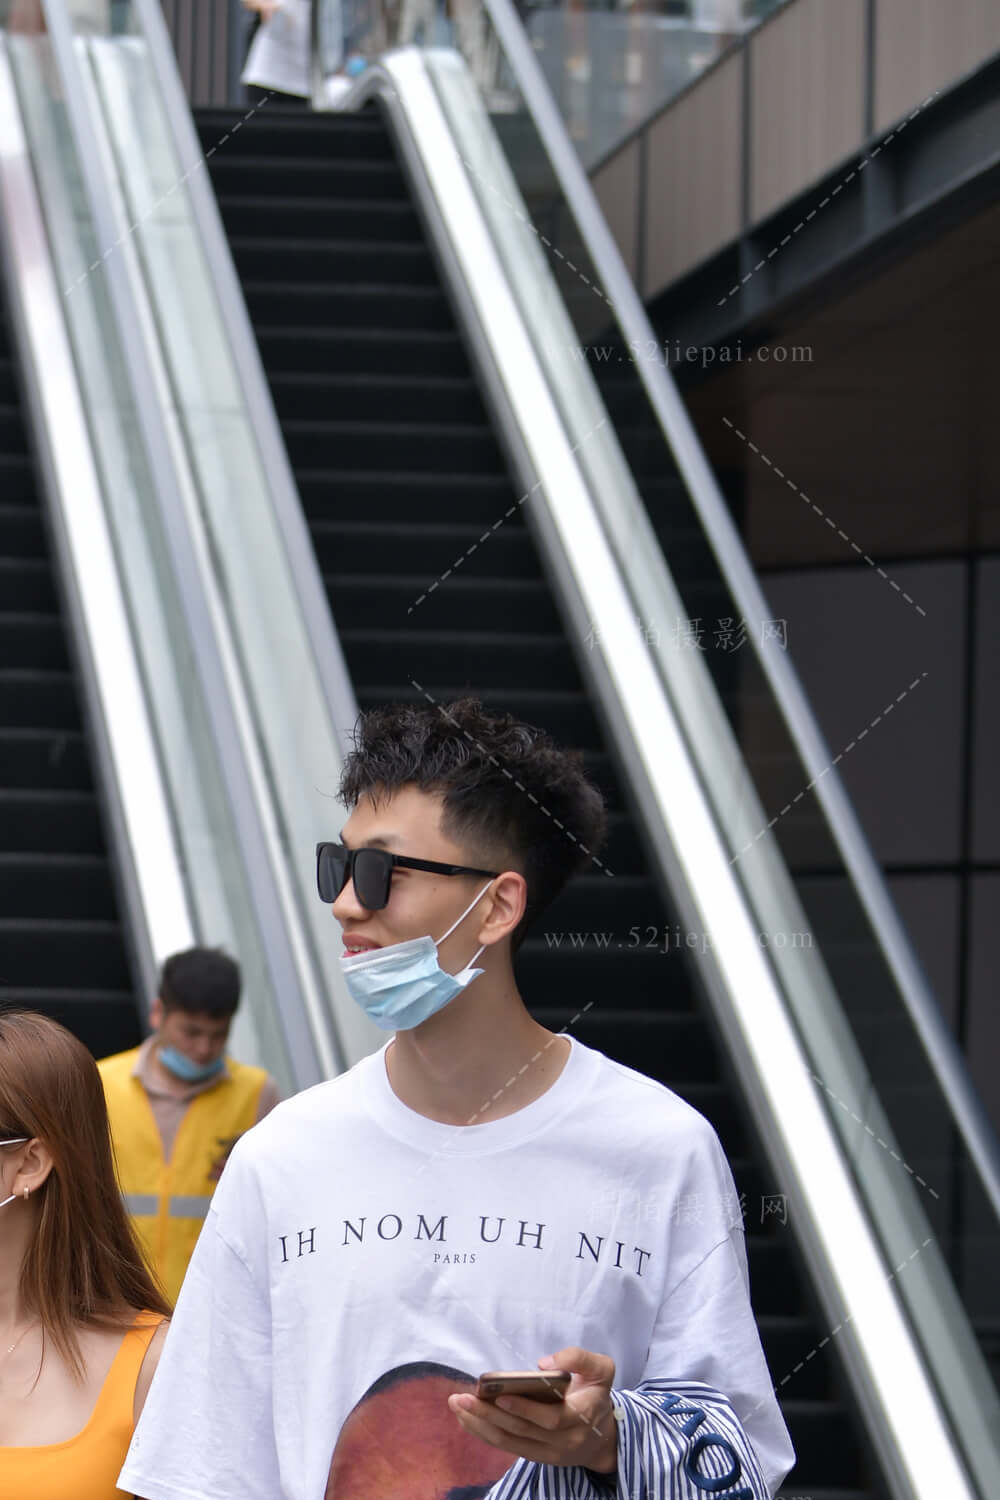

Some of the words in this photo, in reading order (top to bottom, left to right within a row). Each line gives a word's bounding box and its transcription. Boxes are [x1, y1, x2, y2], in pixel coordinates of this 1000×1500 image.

[278, 1227, 317, 1263] IH
[341, 1213, 448, 1246] NOM
[478, 1216, 547, 1250] UH
[575, 1231, 652, 1277] NIT
[433, 1253, 477, 1264] PARIS
